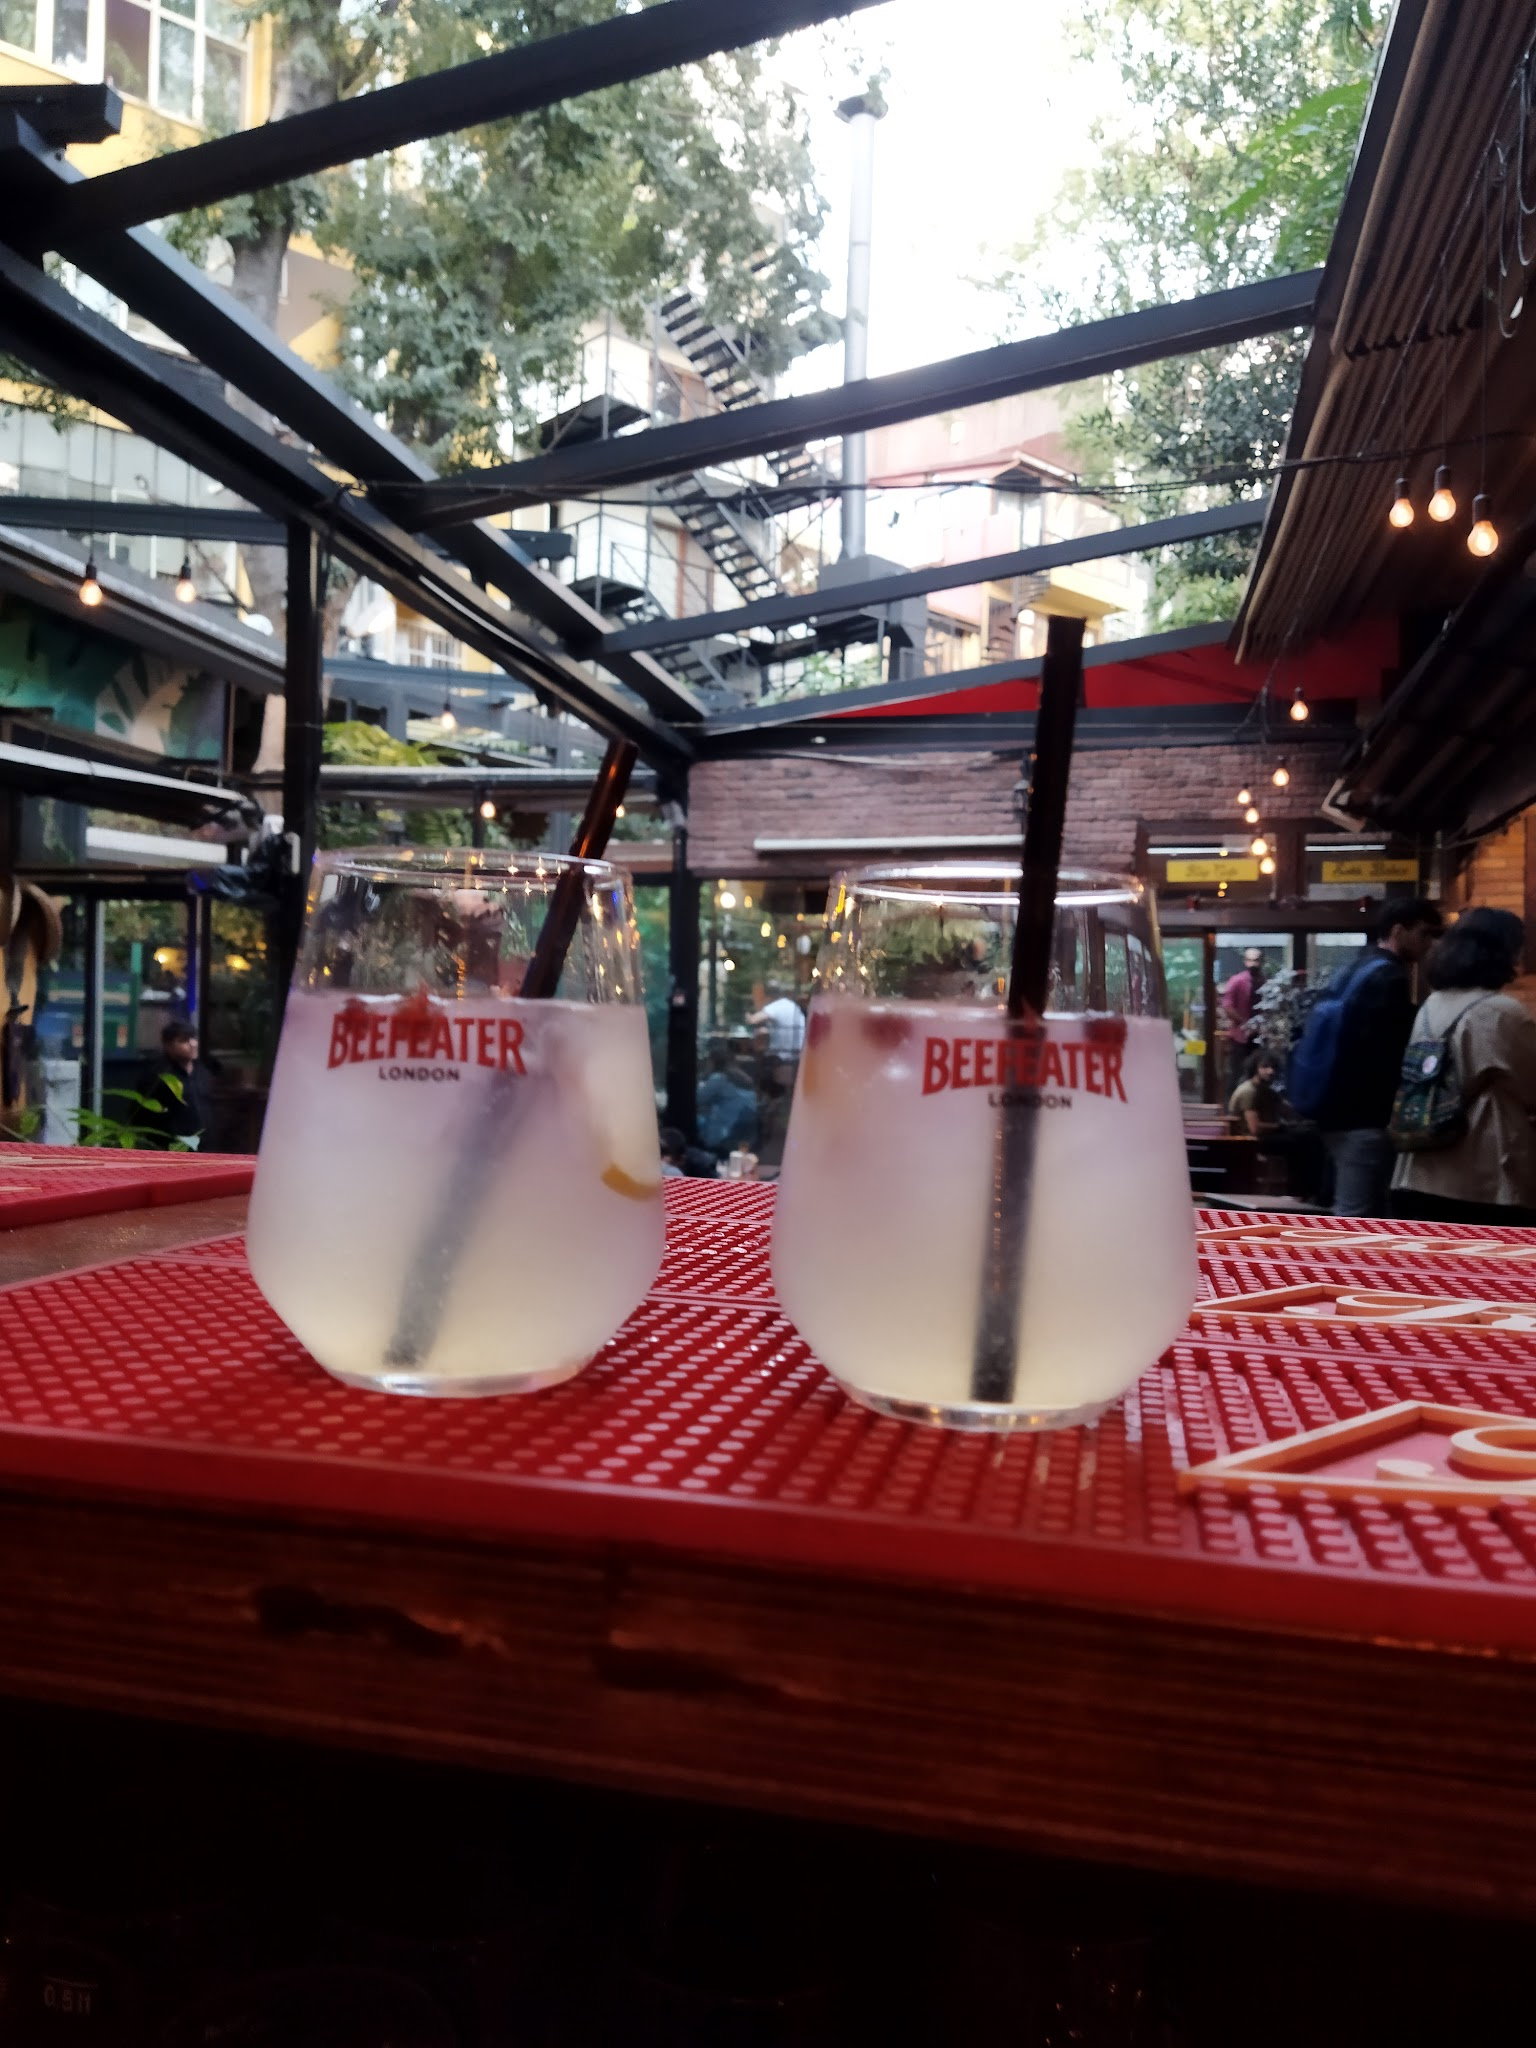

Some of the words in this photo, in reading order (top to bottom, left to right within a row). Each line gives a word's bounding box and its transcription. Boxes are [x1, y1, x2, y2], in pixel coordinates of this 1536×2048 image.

[327, 1013, 527, 1076] BEEFEATER
[379, 1066, 460, 1081] LONDON
[922, 1037, 1128, 1103] BEEFEATER
[988, 1092, 1072, 1109] LODON
